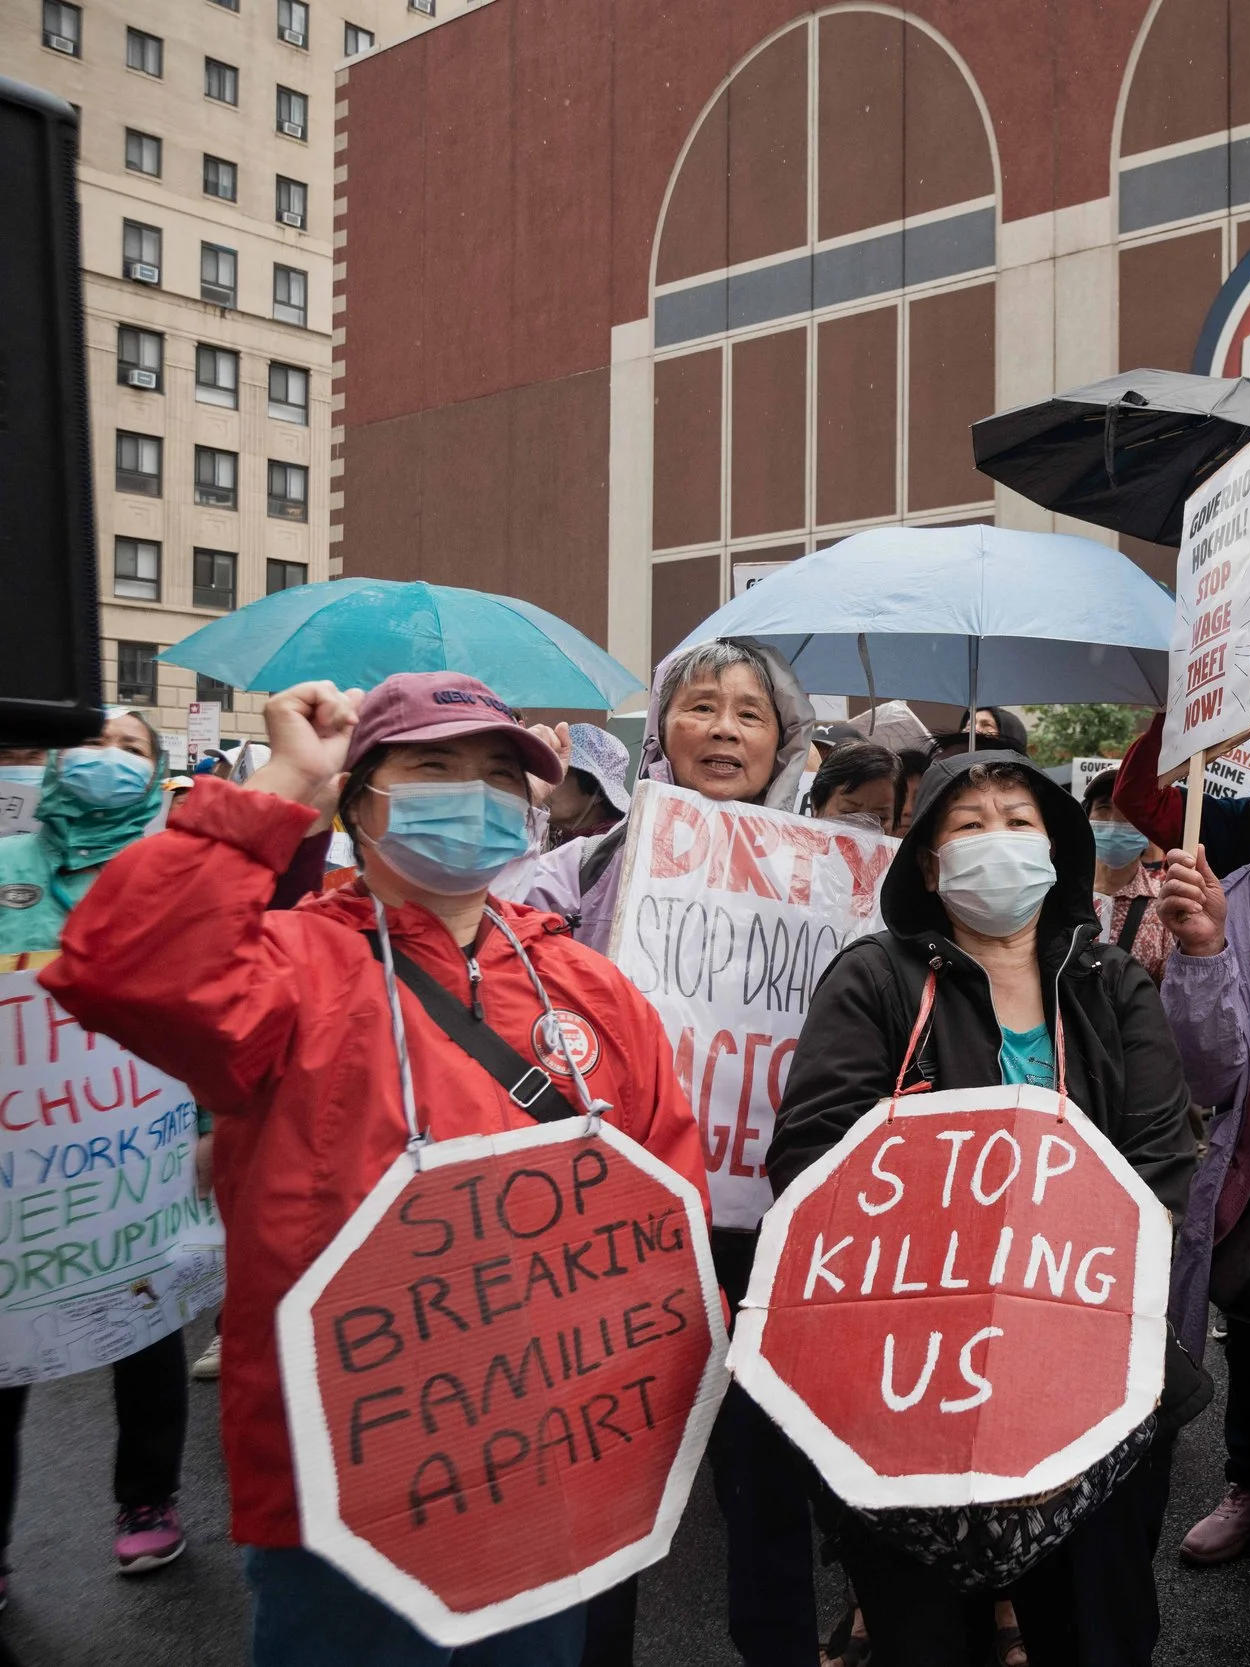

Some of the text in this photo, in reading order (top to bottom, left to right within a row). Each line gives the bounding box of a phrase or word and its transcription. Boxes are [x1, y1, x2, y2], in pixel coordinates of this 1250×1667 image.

[1192, 507, 1249, 575] HOCHUL!
[1195, 559, 1232, 606] STOP
[1191, 599, 1232, 649] WAGE
[1186, 642, 1228, 690] THEFT
[432, 689, 515, 720] NEW YOR
[1183, 687, 1224, 735] NOW!
[650, 797, 895, 918] DIRTY
[633, 894, 735, 1003] STOP
[0, 1059, 163, 1131] CHUL
[29, 1126, 146, 1184] YORK
[161, 1142, 192, 1184] OF
[857, 1128, 1077, 1217] STOP
[400, 1148, 608, 1257] STOP
[333, 1208, 684, 1373] BREAKING
[803, 1225, 1117, 1304] KILLING
[348, 1288, 688, 1464] FAMILIES
[881, 1326, 1004, 1414] US
[408, 1376, 657, 1526] APART
